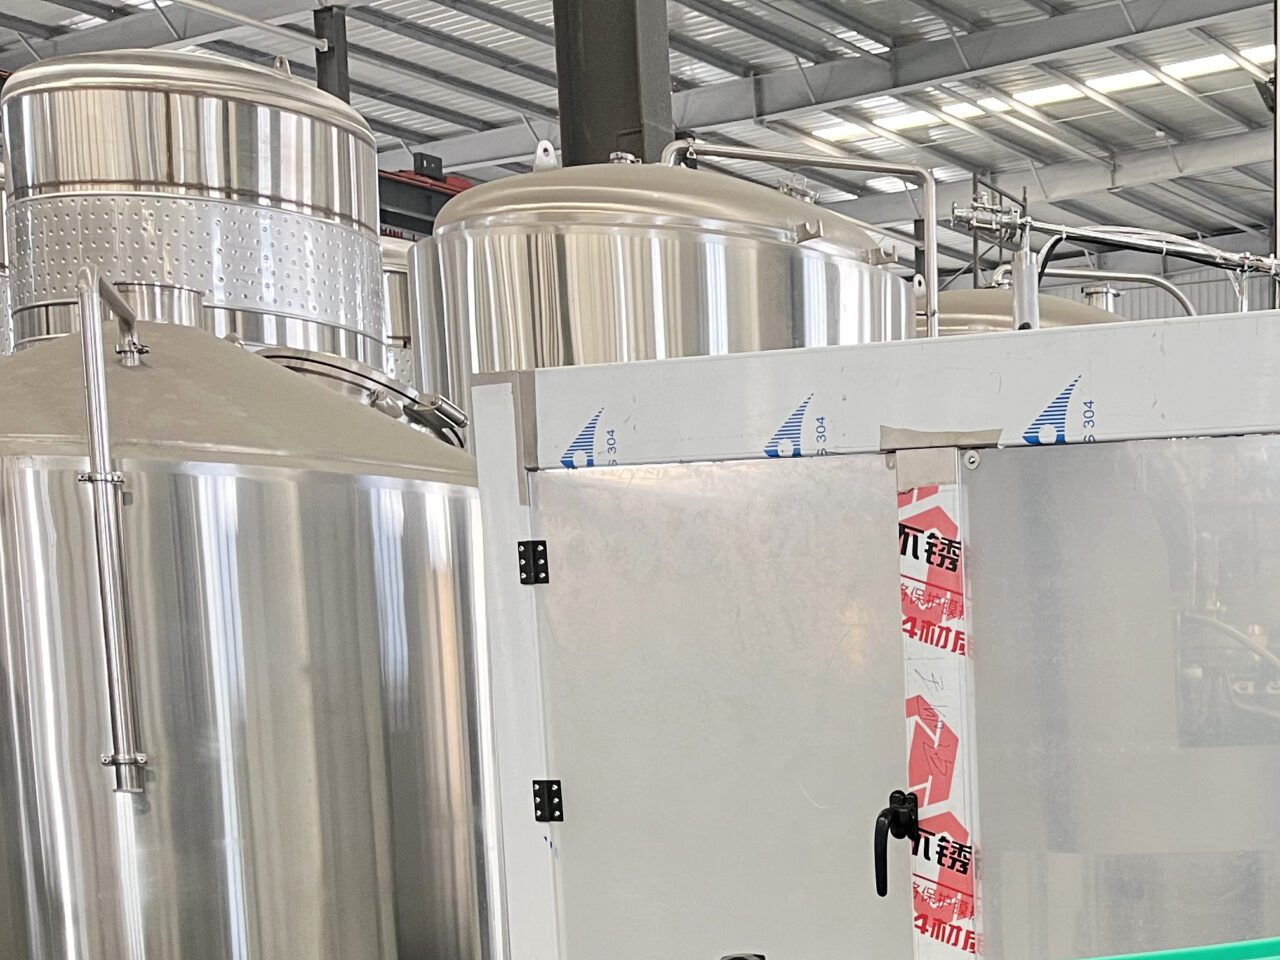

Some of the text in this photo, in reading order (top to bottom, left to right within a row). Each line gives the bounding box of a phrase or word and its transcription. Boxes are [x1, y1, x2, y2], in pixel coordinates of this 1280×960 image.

[1082, 400, 1095, 429] 304
[606, 429, 616, 454] 304
[815, 416, 826, 443] 304
